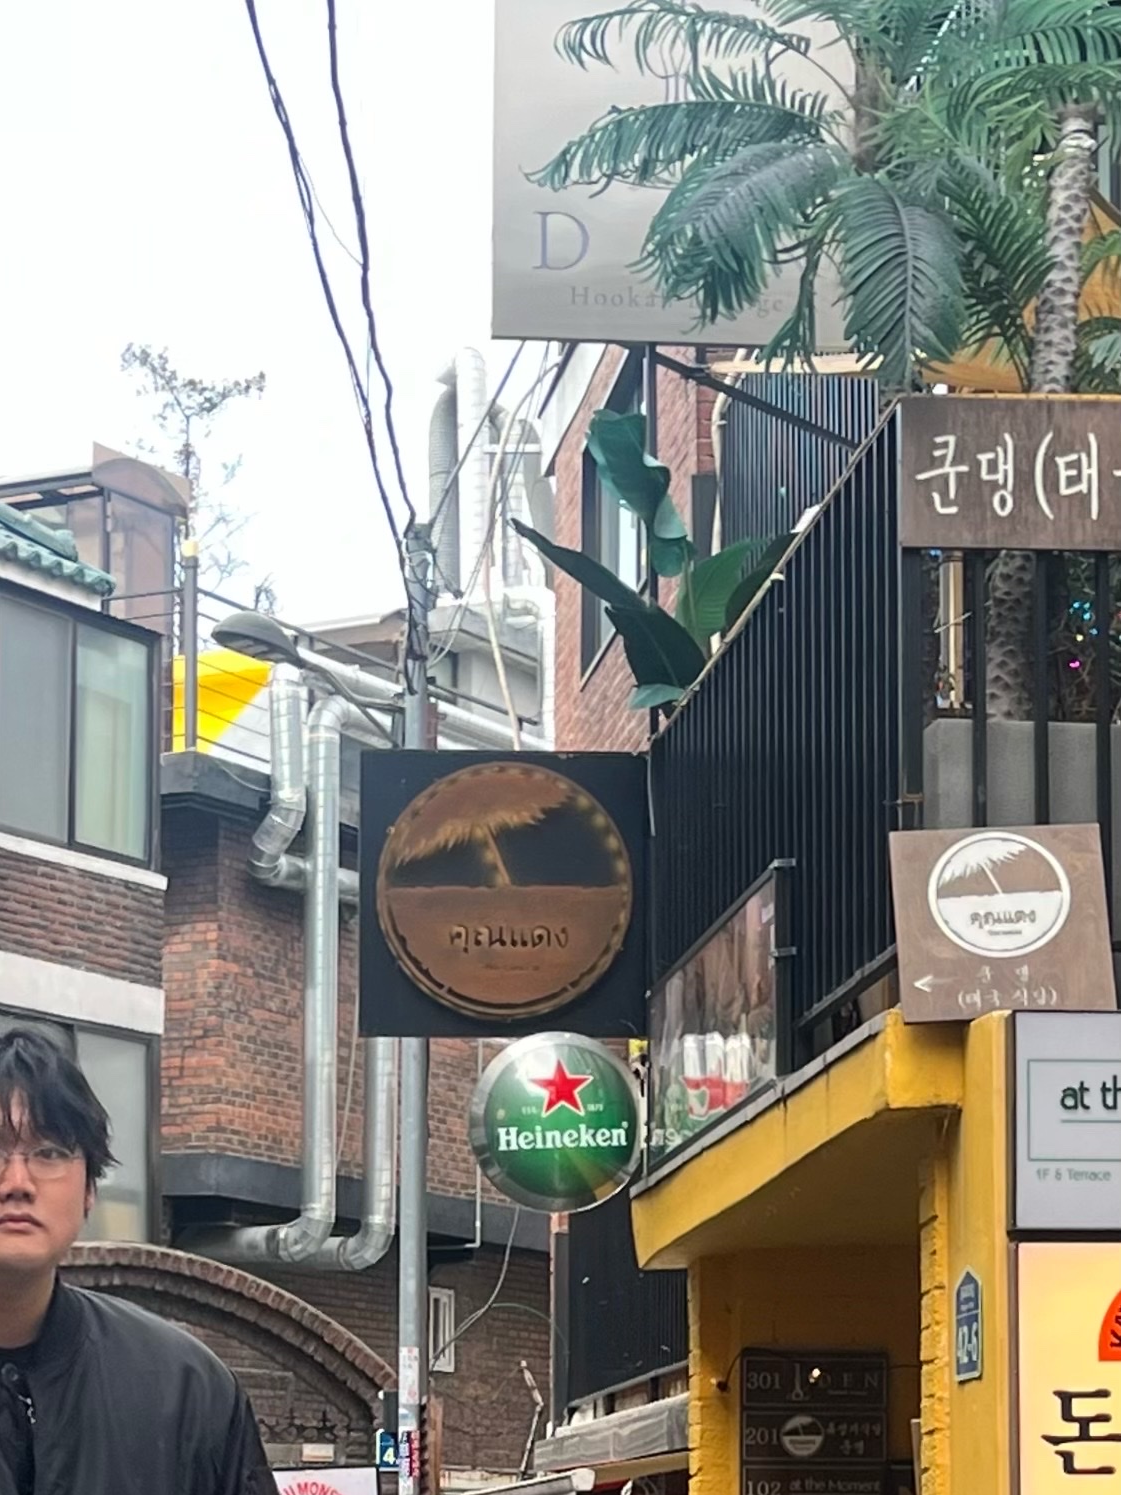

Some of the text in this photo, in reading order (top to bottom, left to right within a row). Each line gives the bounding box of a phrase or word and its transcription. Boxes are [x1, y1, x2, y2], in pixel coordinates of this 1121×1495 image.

[570, 286, 673, 309] Hooka
[1060, 1080, 1091, 1110] at
[497, 1124, 627, 1151] Heineken
[1067, 1169, 1112, 1181] Terrace
[747, 1372, 781, 1390] 301
[745, 1427, 779, 1446] 201
[805, 1475, 826, 1491] the
[828, 1479, 880, 1491] Moment
